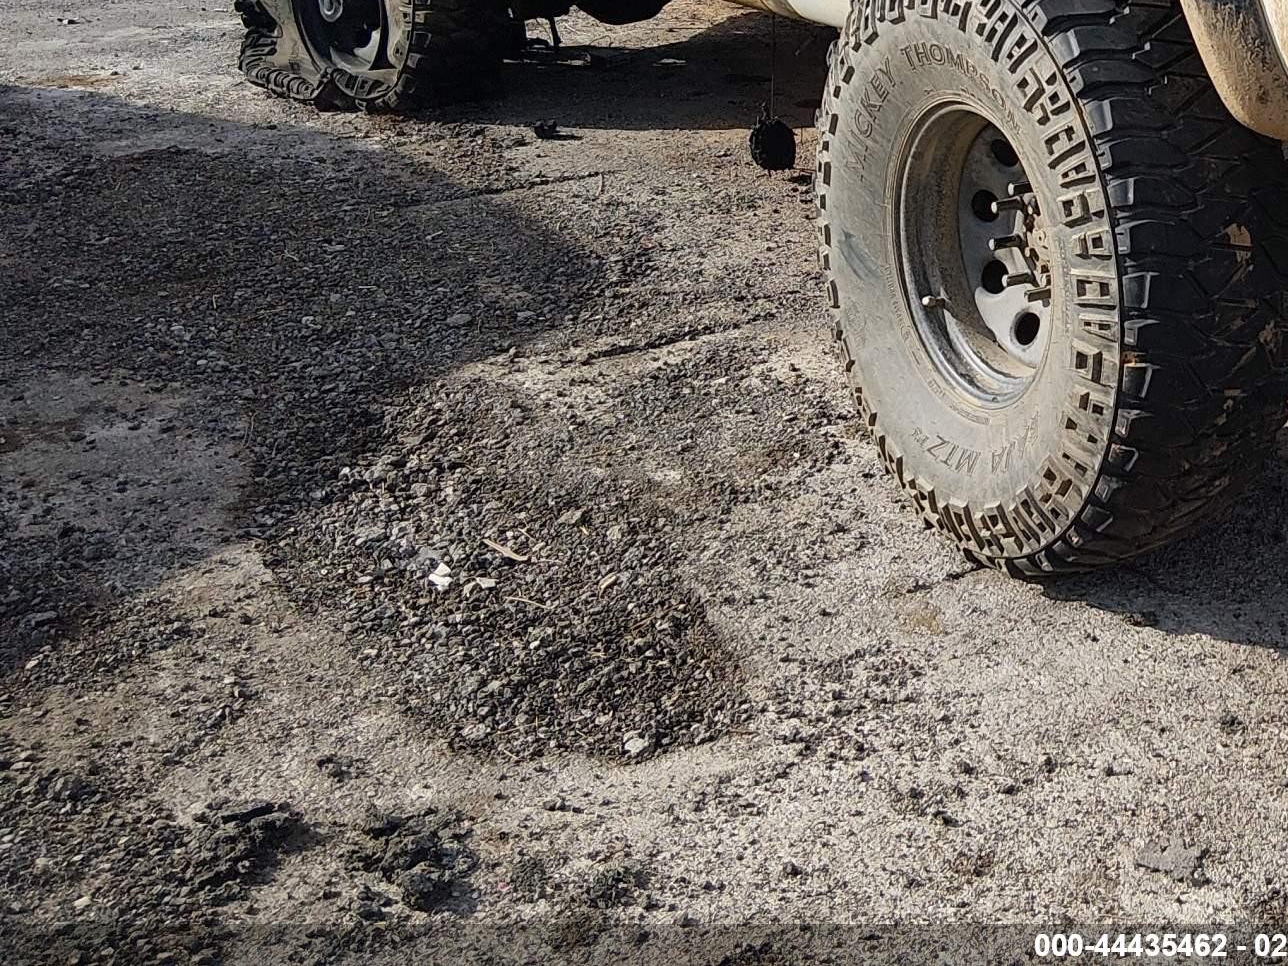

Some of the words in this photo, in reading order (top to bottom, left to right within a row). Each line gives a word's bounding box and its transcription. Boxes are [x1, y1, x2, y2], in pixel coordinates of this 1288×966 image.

[844, 57, 897, 182] MICKEY
[900, 41, 1022, 135] THOMPSON
[926, 433, 982, 476] MTZ
